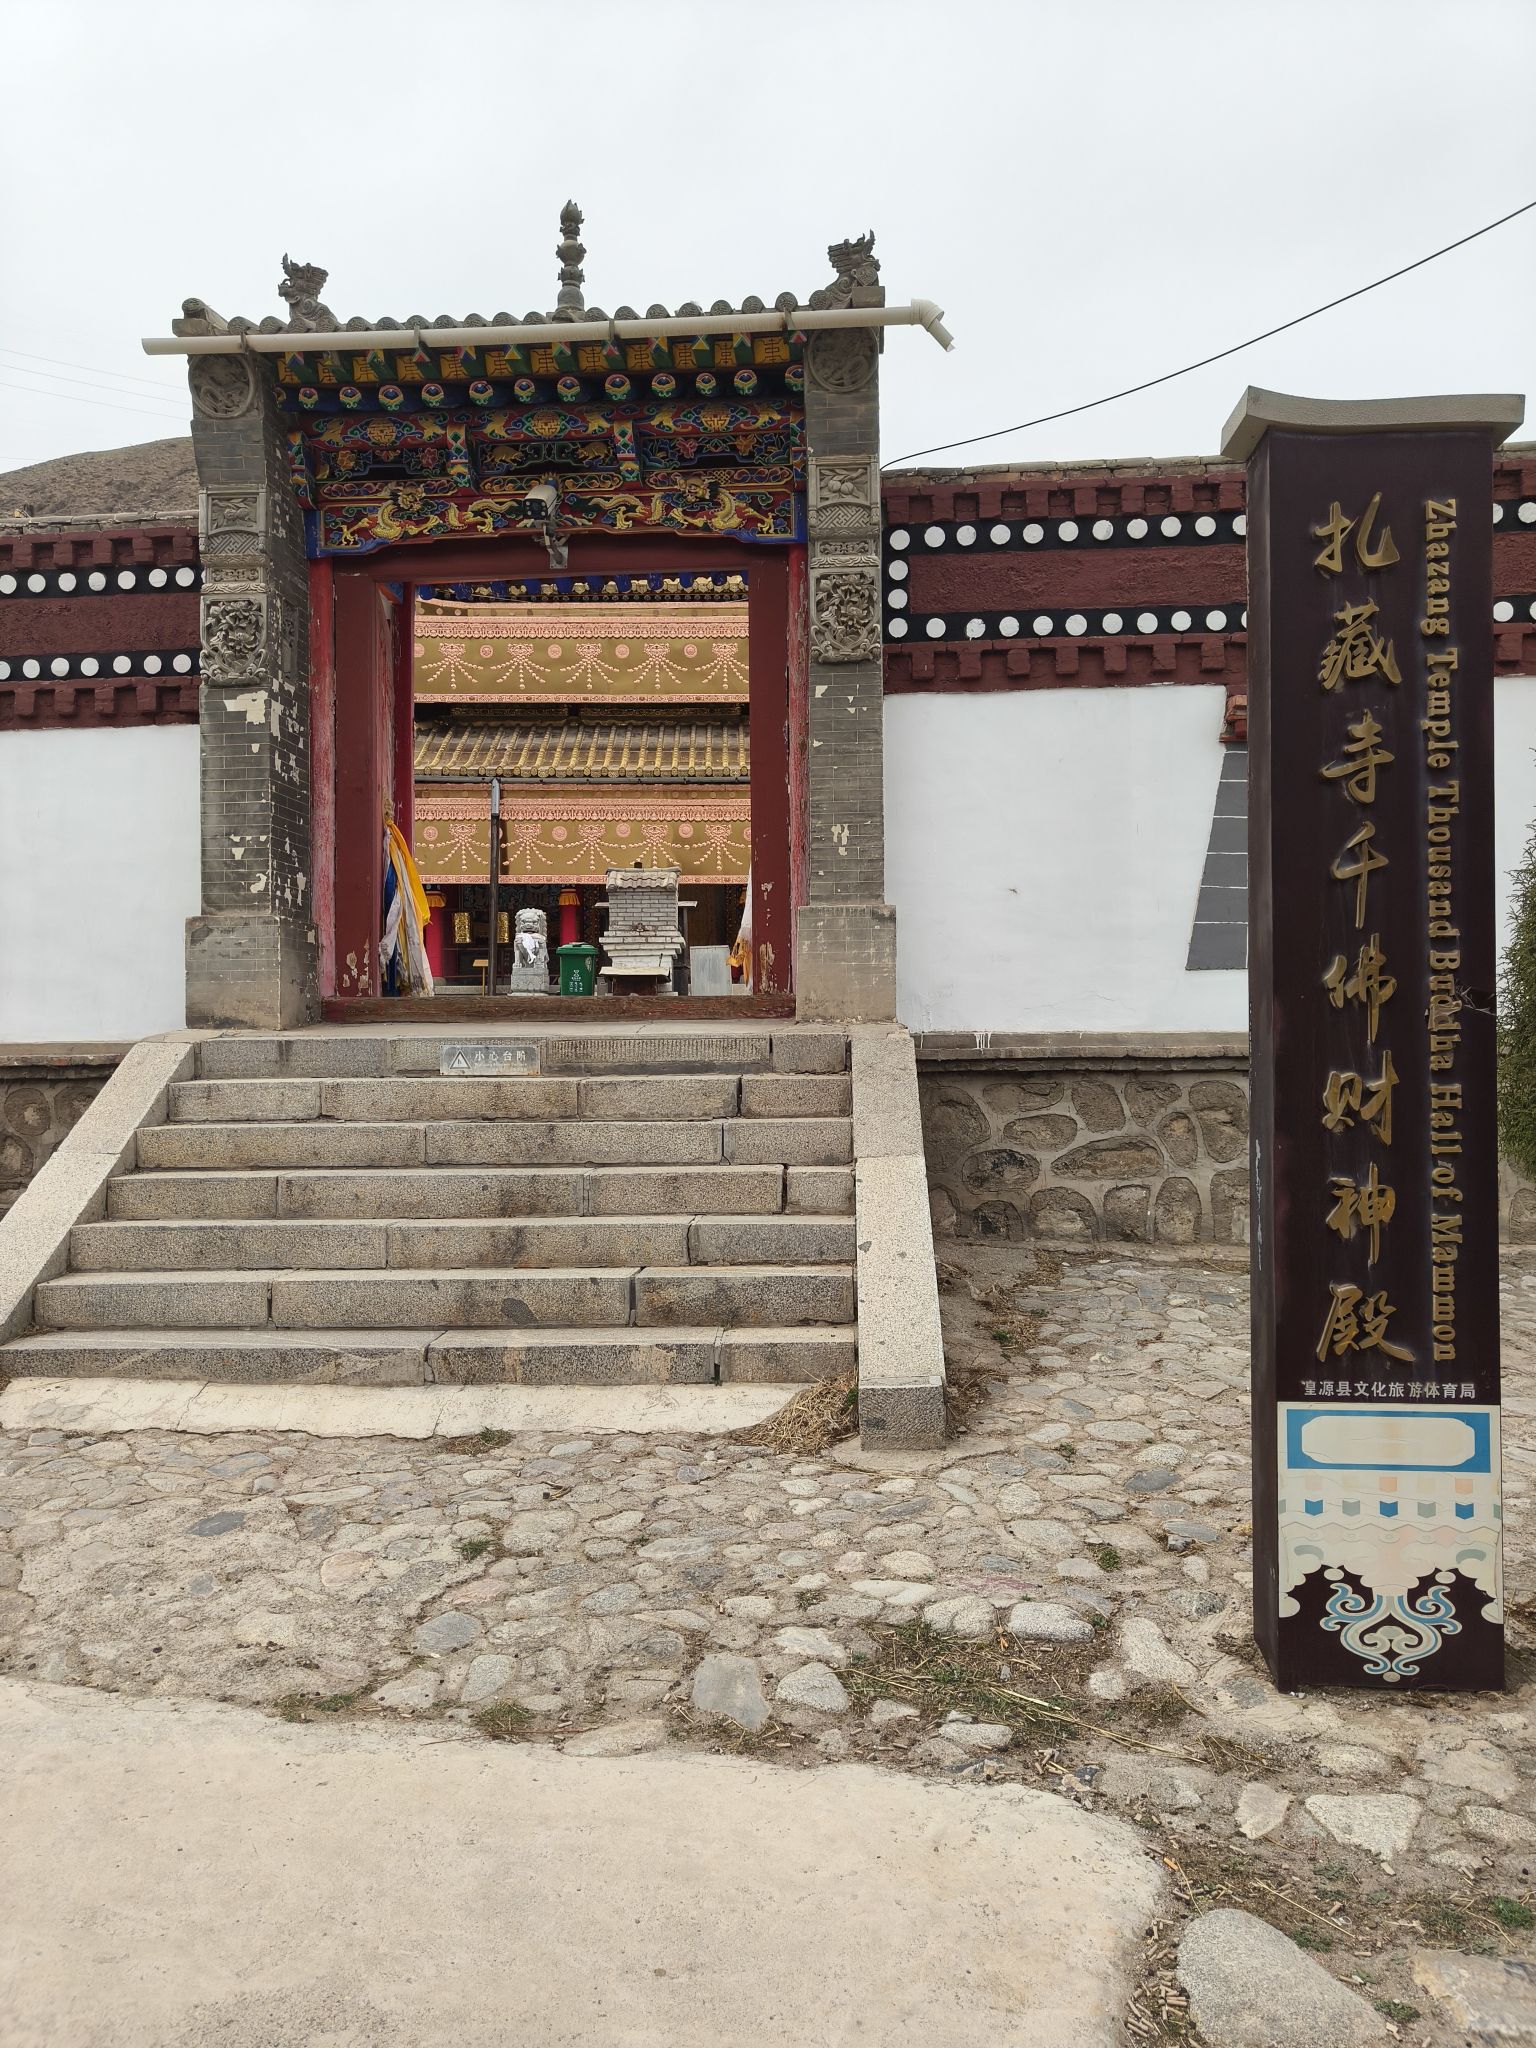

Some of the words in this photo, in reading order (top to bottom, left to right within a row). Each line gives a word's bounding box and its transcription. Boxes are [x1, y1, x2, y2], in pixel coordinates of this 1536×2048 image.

[1420, 498, 1459, 636] Zhazang
[1421, 647, 1459, 769] Temple
[1426, 780, 1460, 939] Thousand
[1312, 491, 1416, 1364] 扎藏寺千佛财神殿
[474, 1050, 527, 1062] 小心台阶
[1426, 950, 1462, 1071] Buddha
[1430, 1083, 1463, 1154] Hall
[1431, 1158, 1464, 1202] of
[1431, 1214, 1464, 1361] Mammon
[1301, 1380, 1477, 1400] 湟源县文化旅游体育局
